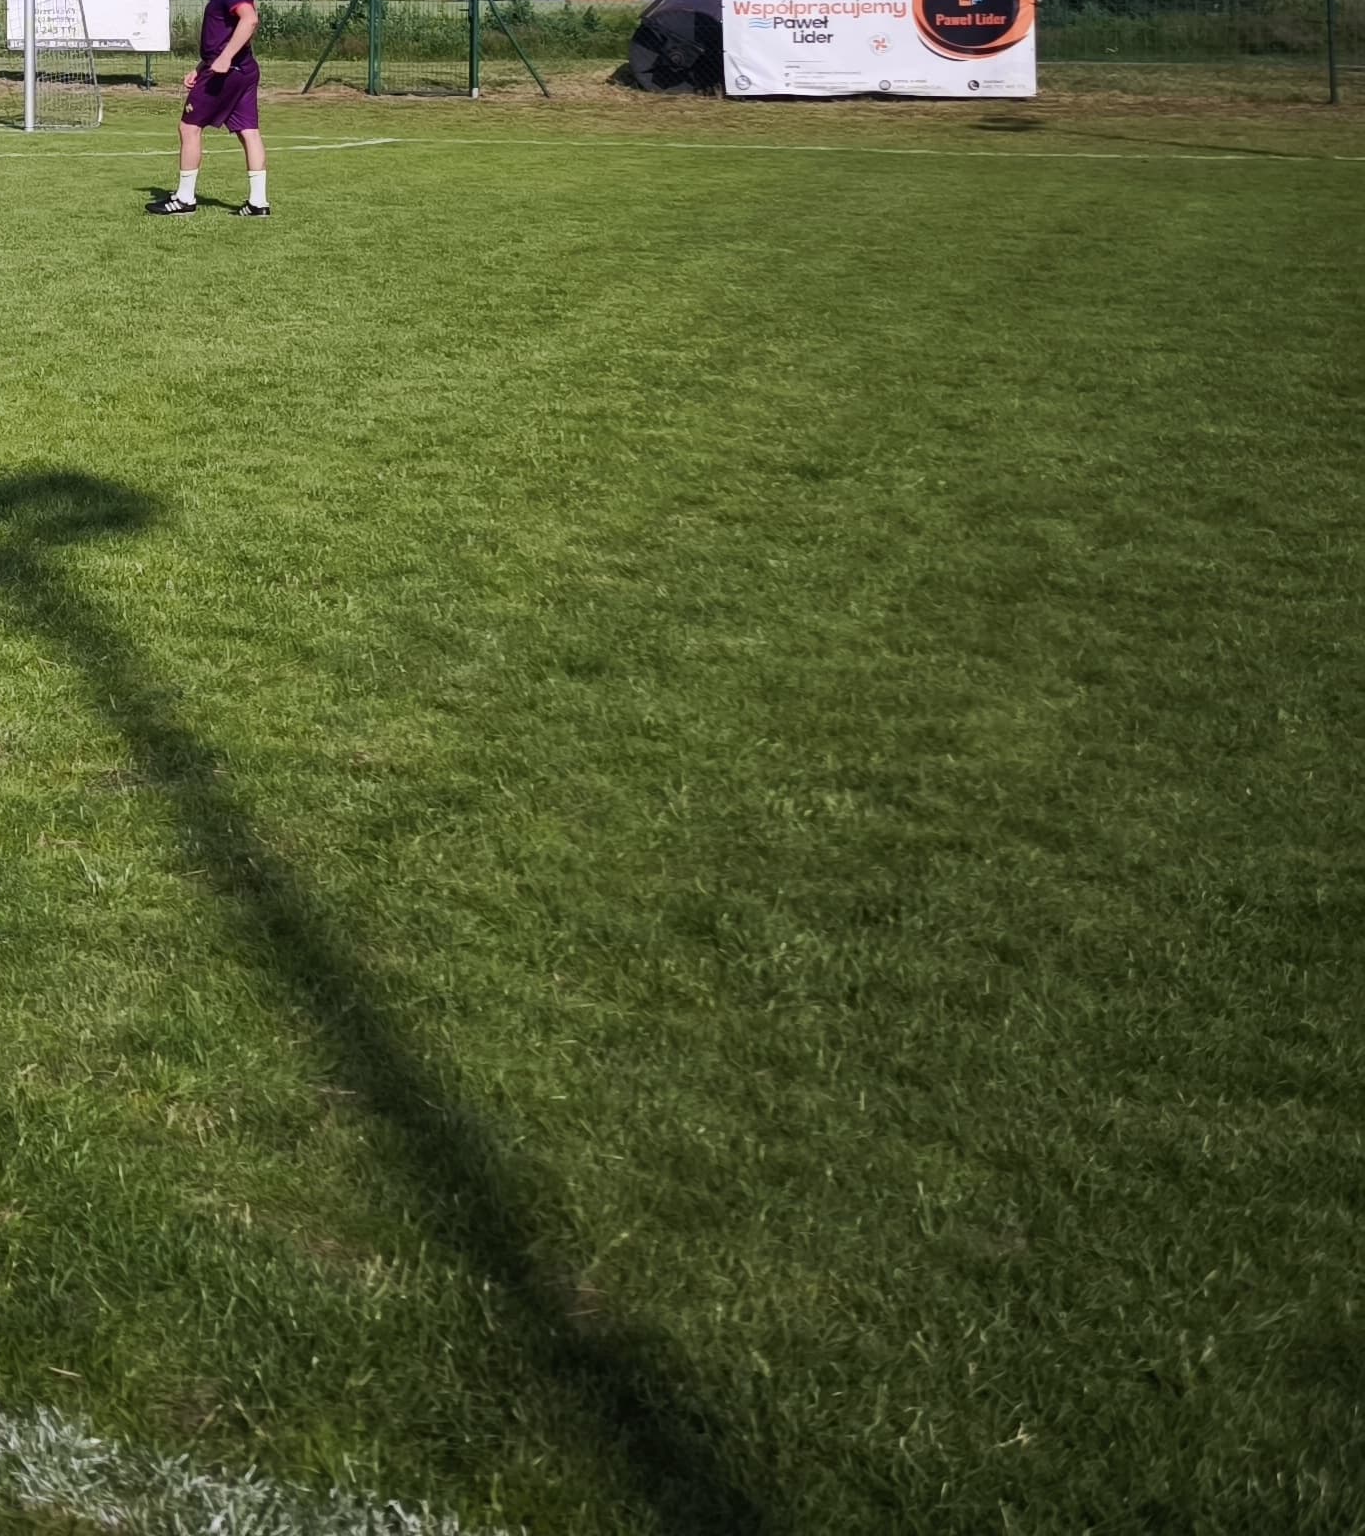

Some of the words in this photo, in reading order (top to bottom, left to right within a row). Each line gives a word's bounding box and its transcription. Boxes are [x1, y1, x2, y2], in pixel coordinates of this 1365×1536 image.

[733, 0, 907, 19] Współpracujemy
[773, 16, 829, 29] Paweł
[975, 14, 1007, 26] Lider
[793, 30, 834, 44] Lider
